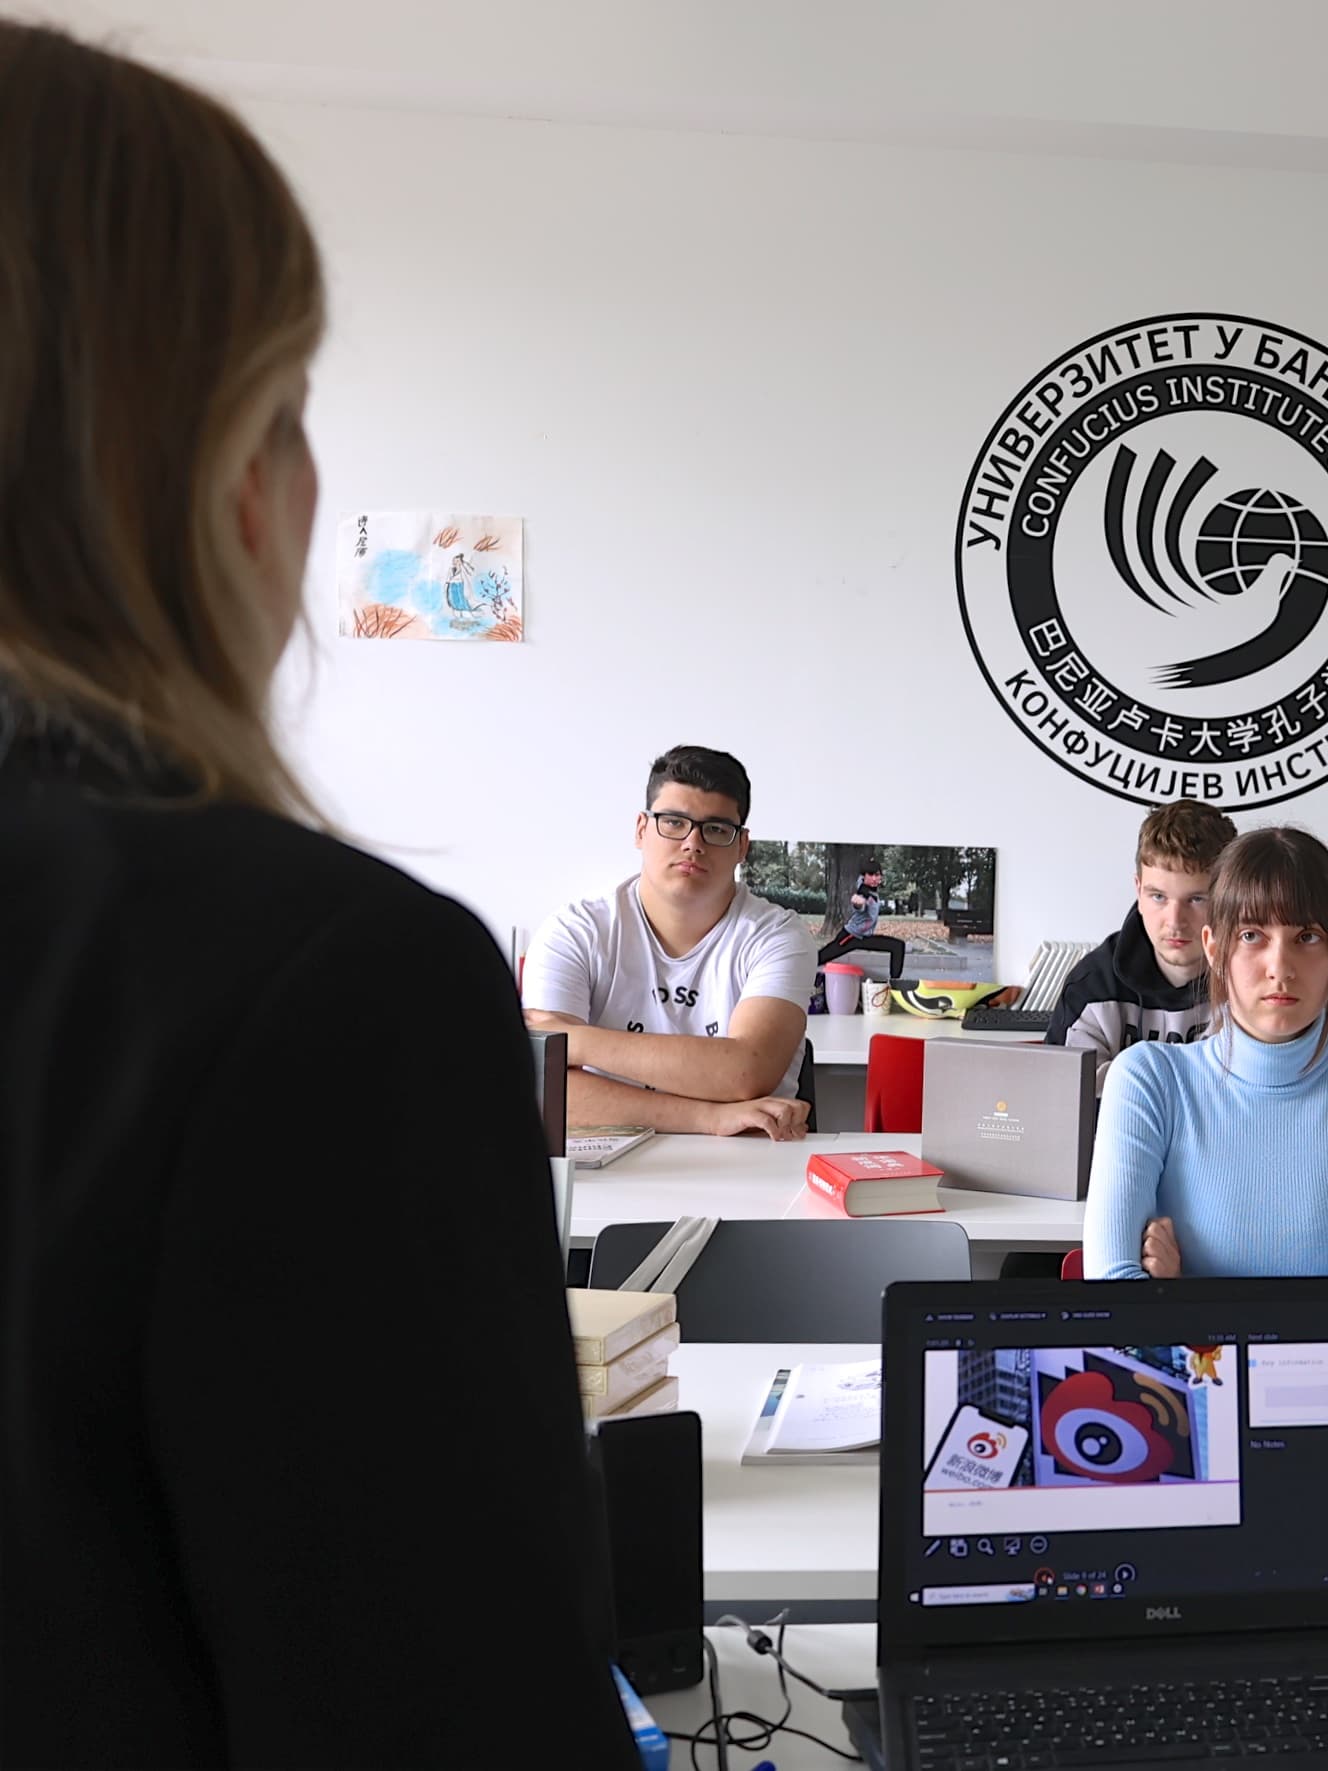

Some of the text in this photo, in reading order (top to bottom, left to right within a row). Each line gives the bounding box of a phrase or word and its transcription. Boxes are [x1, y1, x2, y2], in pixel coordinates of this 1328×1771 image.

[967, 325, 1201, 552] УНИВЕРЗИТЕТ
[1213, 325, 1244, 360] У
[1021, 384, 1160, 539] CONFUCIUS
[1004, 669, 1224, 800] КОНФУЦИЈЕВ
[1145, 1606, 1182, 1620] DELL
